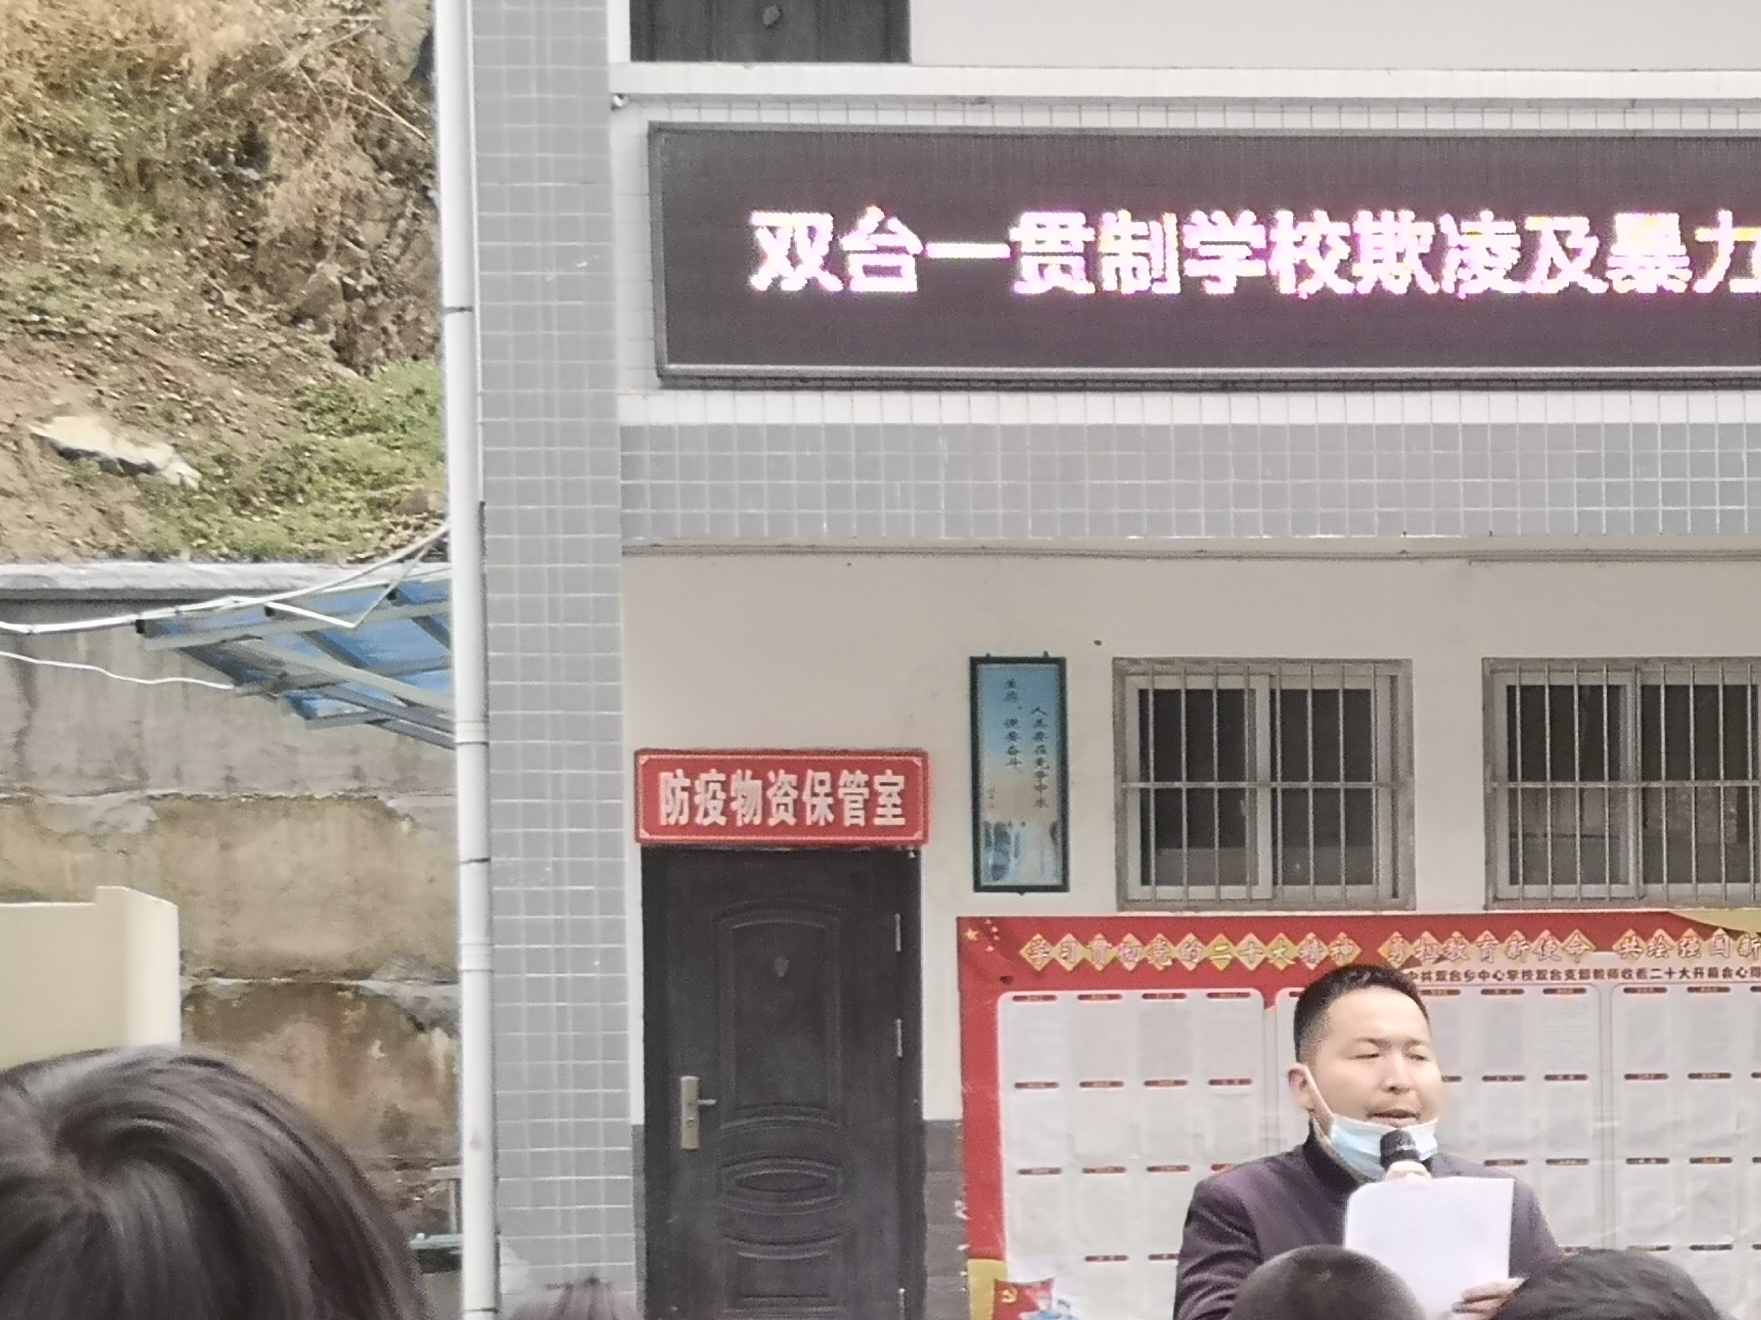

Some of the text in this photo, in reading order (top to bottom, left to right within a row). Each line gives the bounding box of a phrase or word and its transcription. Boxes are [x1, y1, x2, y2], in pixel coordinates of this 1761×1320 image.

[658, 767, 907, 827] 防疫物资保管室
[1026, 932, 1358, 971] 学习贯彻党的二十大精神
